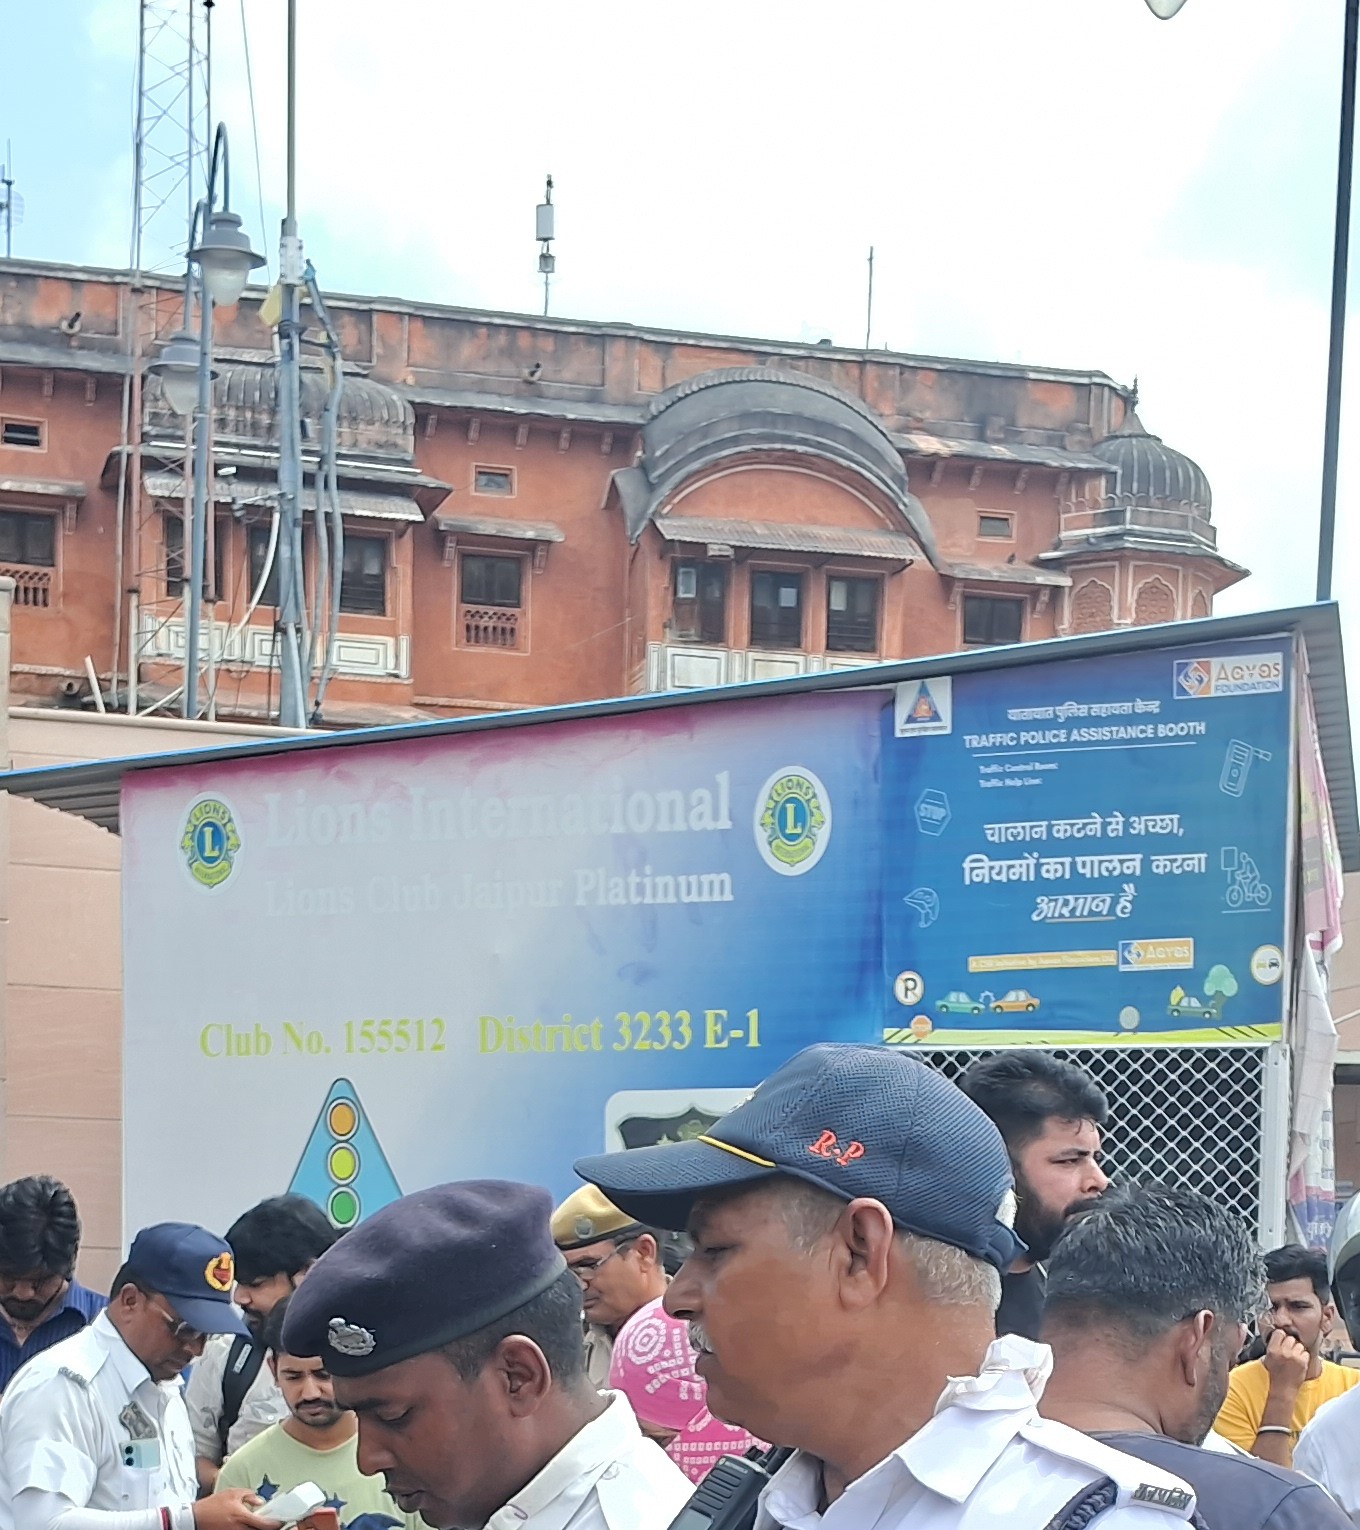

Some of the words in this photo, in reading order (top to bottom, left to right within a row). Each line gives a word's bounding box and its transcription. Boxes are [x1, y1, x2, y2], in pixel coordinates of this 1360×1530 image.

[1216, 680, 1280, 694] FOUNDATION
[1055, 701, 1088, 723] पुलिस
[1090, 701, 1133, 718] सहायता
[963, 733, 1017, 749] TRAFFIC
[1020, 729, 1068, 745] POLICE
[1070, 724, 1154, 742] ASSISTANCE
[1157, 721, 1206, 738] BOOTH
[773, 778, 812, 798] LIONS
[192, 802, 229, 822] LIONS
[266, 789, 394, 848] Lions
[409, 771, 733, 842] International
[785, 803, 802, 834] L
[203, 826, 220, 857] L
[984, 821, 1048, 843] चालान
[1051, 812, 1103, 840] कटने
[1105, 811, 1125, 837] से
[1129, 814, 1184, 837] अच्छा,
[962, 852, 1039, 885] नियमों
[1040, 857, 1072, 880] का
[1075, 854, 1143, 878] पालन
[1150, 853, 1208, 875] करना
[266, 878, 353, 918] Lions
[368, 873, 441, 914] Club
[453, 871, 563, 916] Jaipur
[575, 869, 734, 906] Platinum
[1031, 893, 1115, 921] आसान
[1115, 883, 1138, 918] है
[200, 1020, 273, 1058] Club
[281, 1020, 331, 1055] No.
[343, 1018, 446, 1054] 155512
[477, 1013, 602, 1055] District
[612, 1009, 693, 1051] 3233
[703, 1007, 761, 1049] E-1
